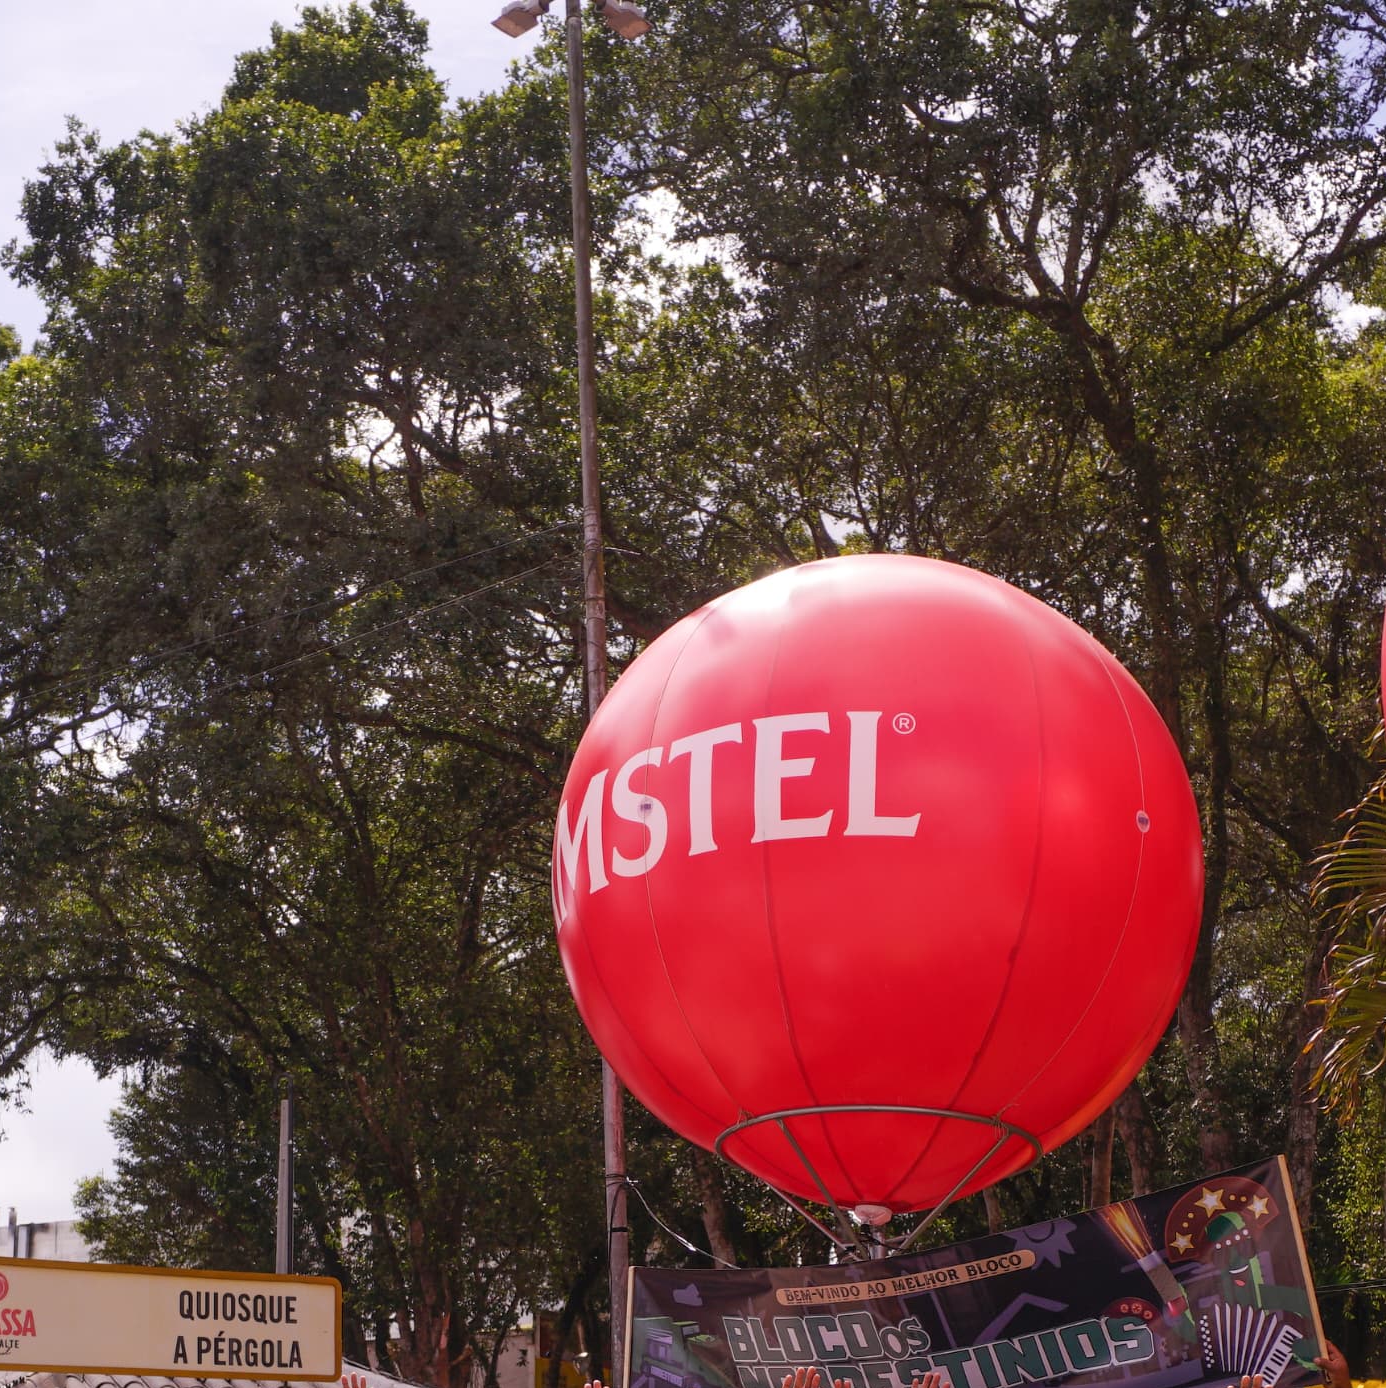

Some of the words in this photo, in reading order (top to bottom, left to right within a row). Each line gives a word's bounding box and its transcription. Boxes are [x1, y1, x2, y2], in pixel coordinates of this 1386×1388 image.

[552, 711, 922, 932] MSTEL
[784, 1285, 860, 1303] BEM-VINDO
[867, 1283, 886, 1297] AO
[892, 1269, 959, 1293] MELHOR
[966, 1254, 1023, 1277] BLOCO
[179, 1291, 298, 1324] QUIOSQUE
[173, 1336, 188, 1364] A
[197, 1332, 303, 1369] PÉRGOLA
[722, 1311, 883, 1363] BLOCO
[880, 1316, 932, 1361] OS
